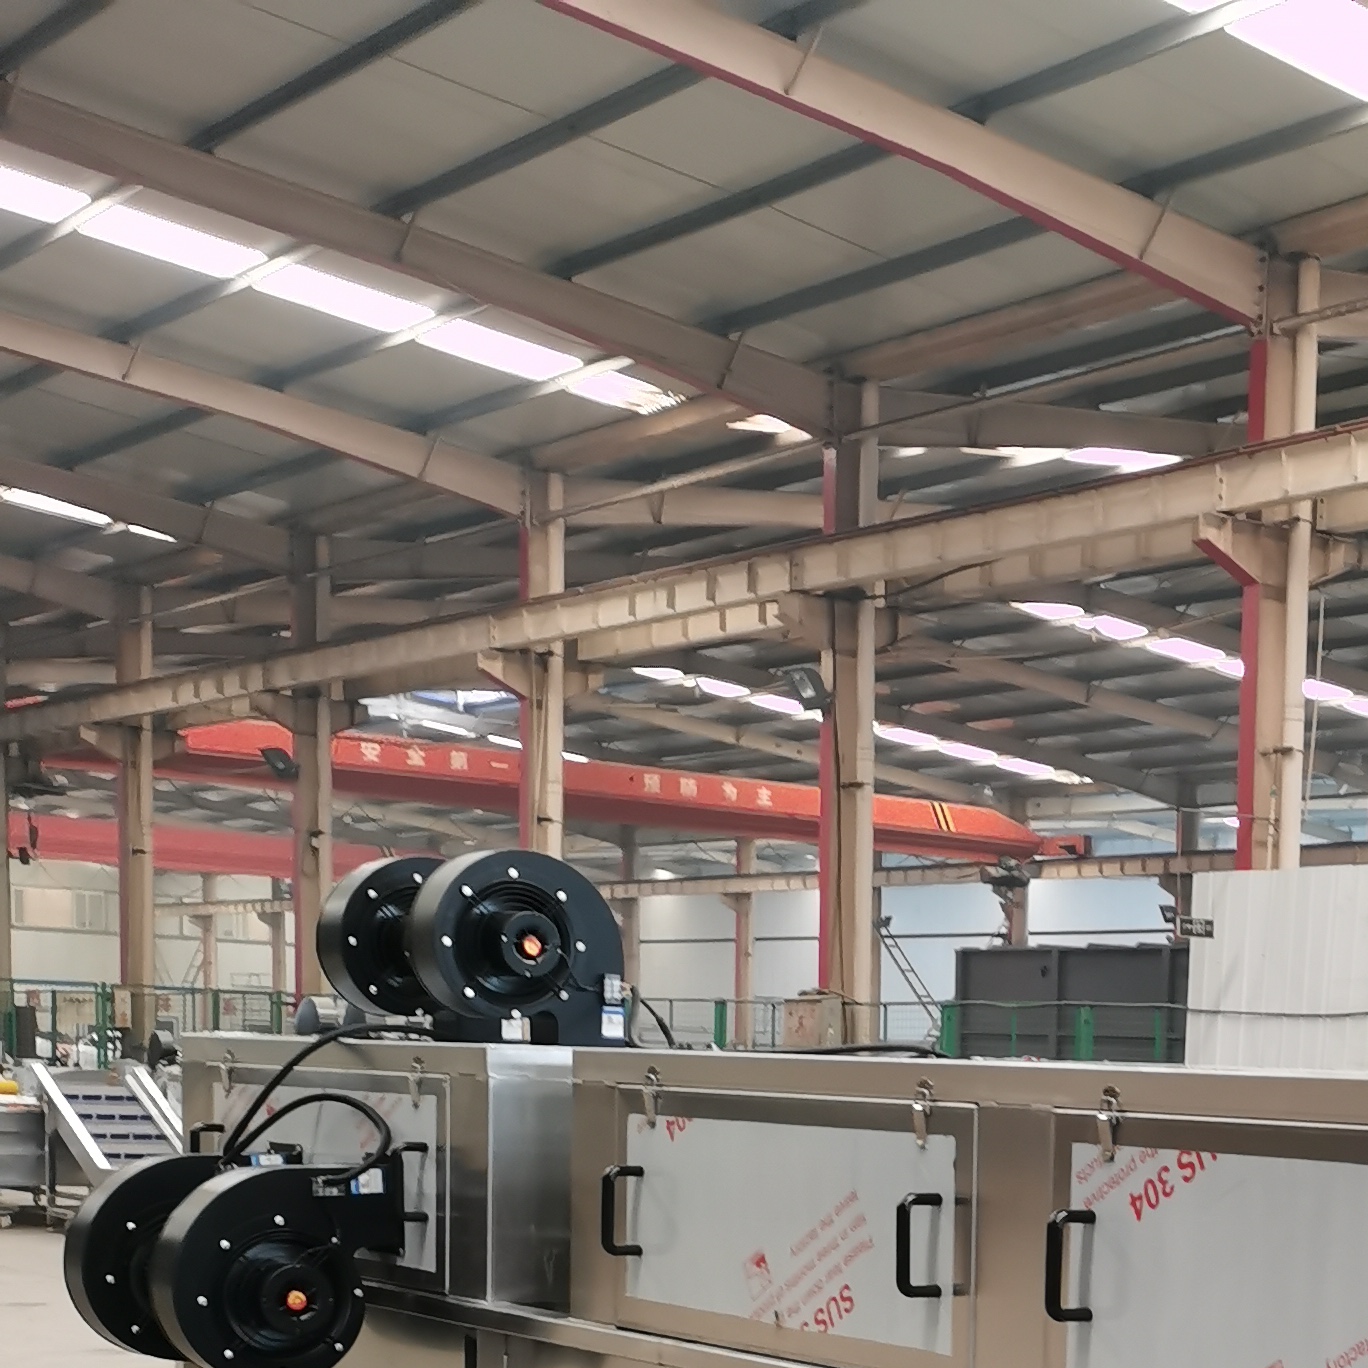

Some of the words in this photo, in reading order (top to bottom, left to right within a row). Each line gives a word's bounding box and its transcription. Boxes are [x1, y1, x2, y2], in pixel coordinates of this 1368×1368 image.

[666, 1116, 693, 1142] 04
[1129, 1165, 1175, 1222] 304
[814, 1284, 855, 1334] SUS
